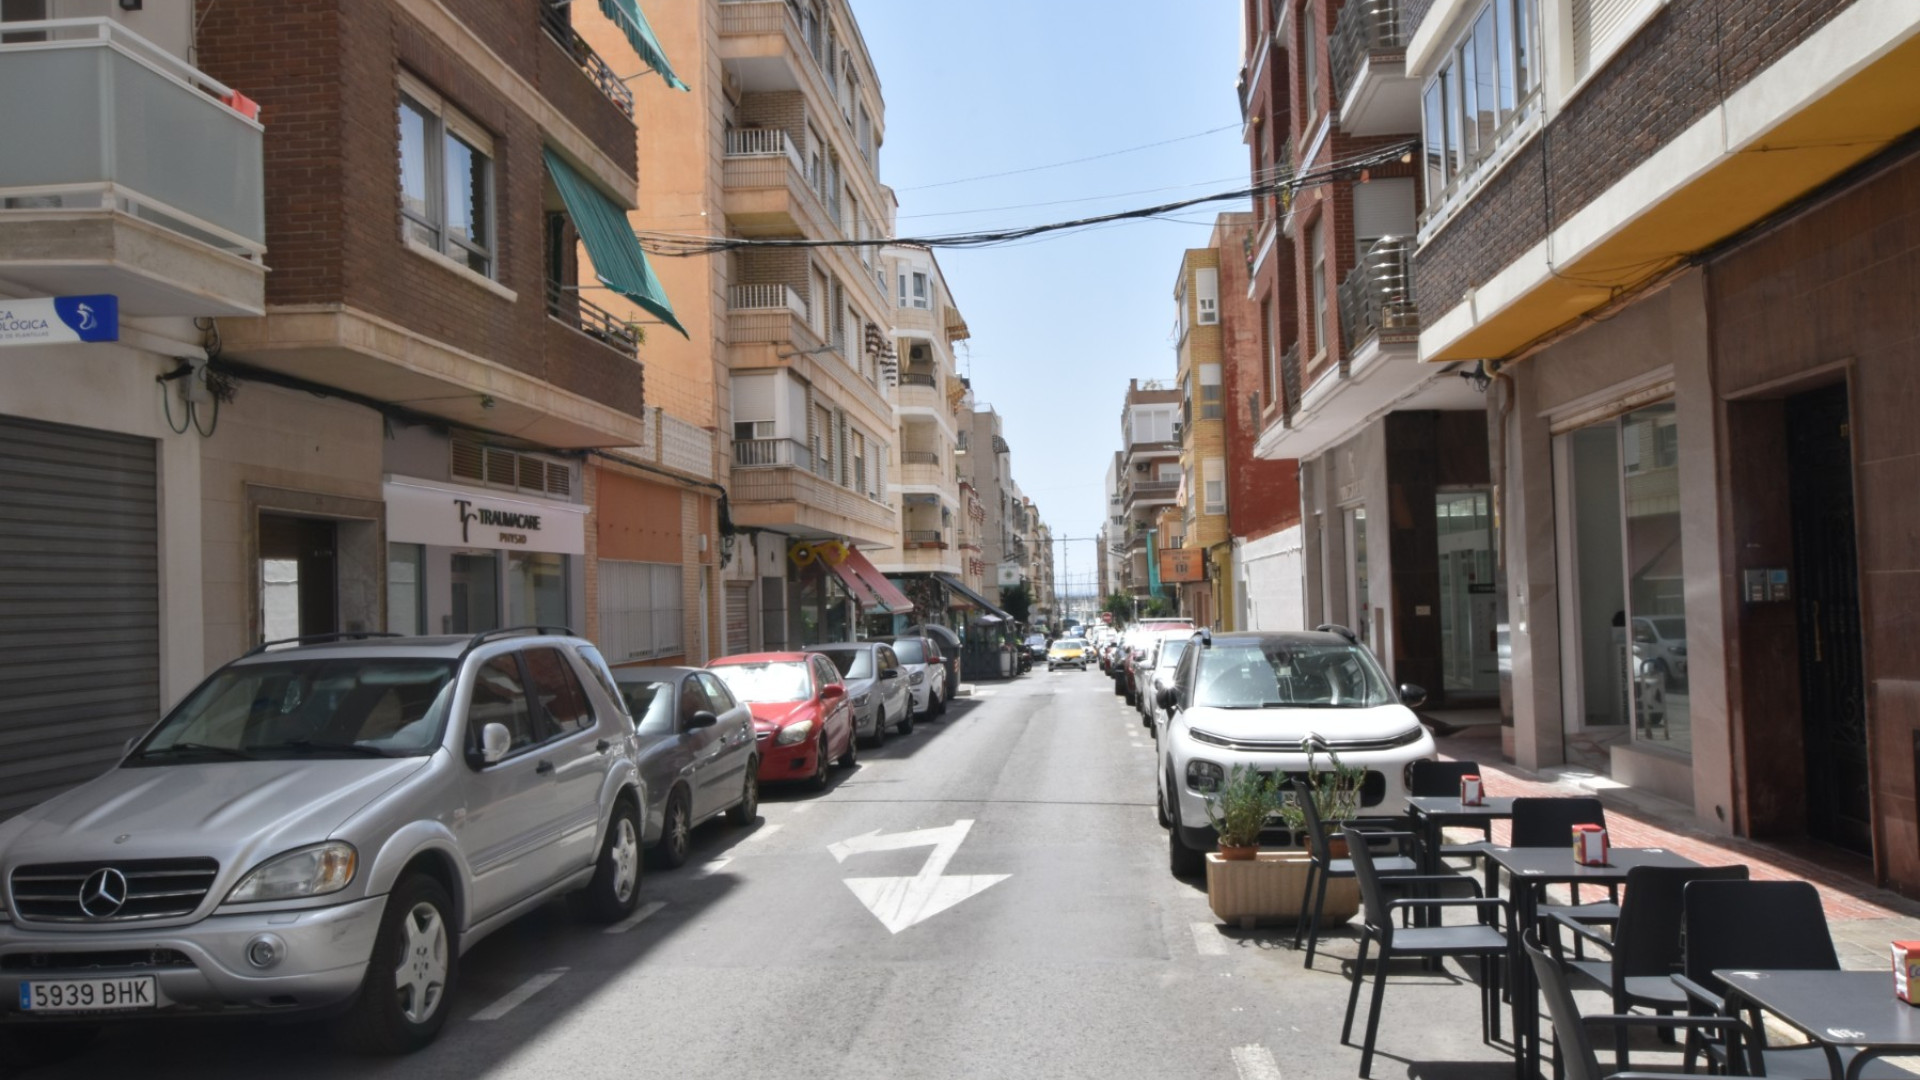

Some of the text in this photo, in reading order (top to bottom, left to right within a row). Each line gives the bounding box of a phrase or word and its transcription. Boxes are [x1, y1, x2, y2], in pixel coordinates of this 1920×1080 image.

[478, 508, 541, 530] TRAUMACARE
[500, 532, 527, 544] PHYSIO
[35, 980, 149, 1006] 5939 BHK
